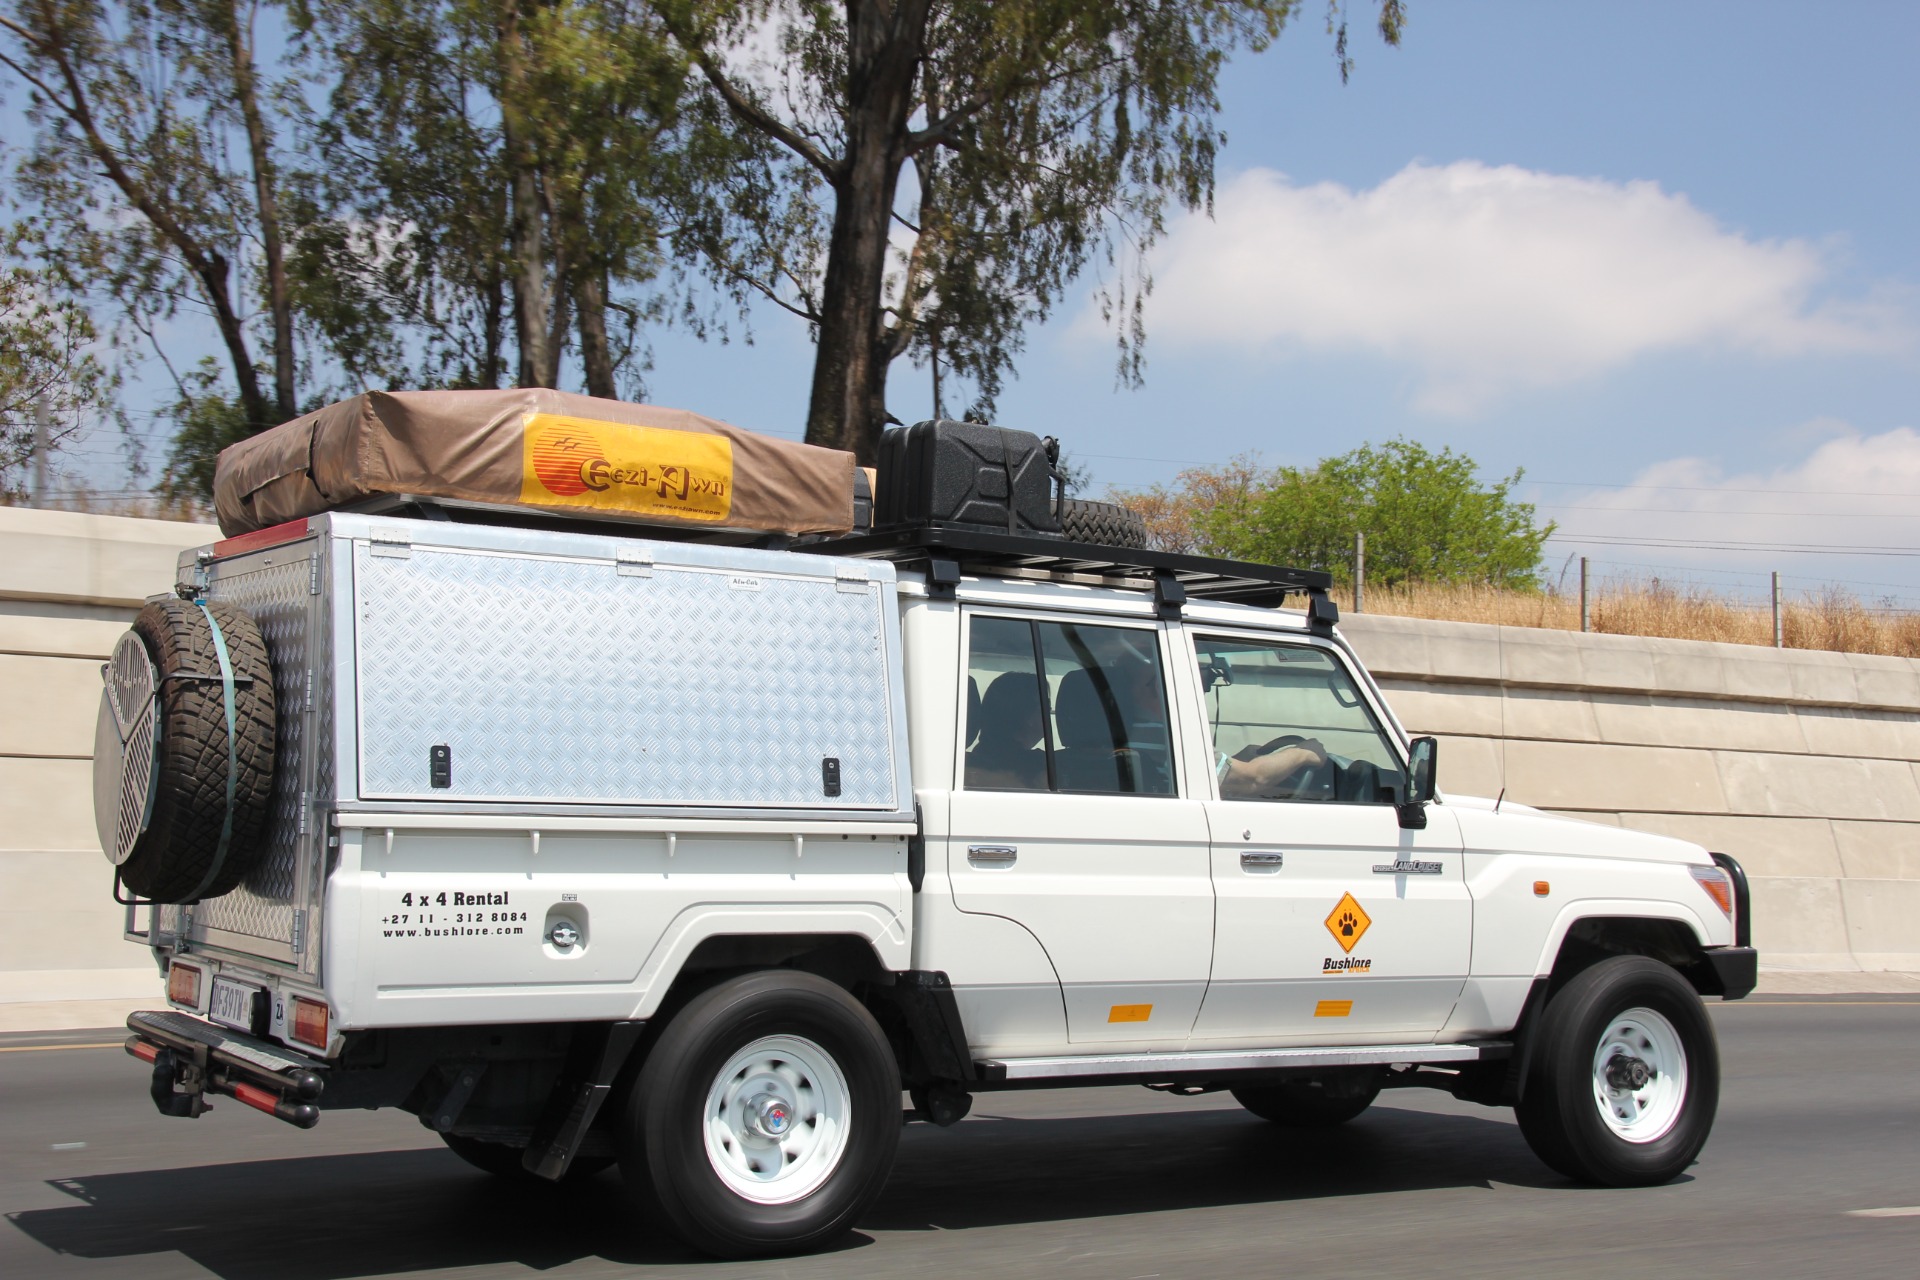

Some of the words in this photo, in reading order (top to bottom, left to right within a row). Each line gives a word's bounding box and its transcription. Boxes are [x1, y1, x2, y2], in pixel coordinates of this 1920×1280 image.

[579, 457, 725, 500] Eezi-Awn
[401, 892, 412, 906] 4
[420, 896, 429, 906] x
[436, 892, 447, 906] 4
[454, 891, 508, 906] Rental
[382, 914, 409, 924] +27
[419, 914, 433, 924] 11
[456, 913, 483, 923] 312
[491, 912, 527, 922] 8084
[383, 926, 523, 938] www.bushlore.com
[1323, 957, 1371, 969] Bushlore
[276, 1003, 284, 1021] ZA
